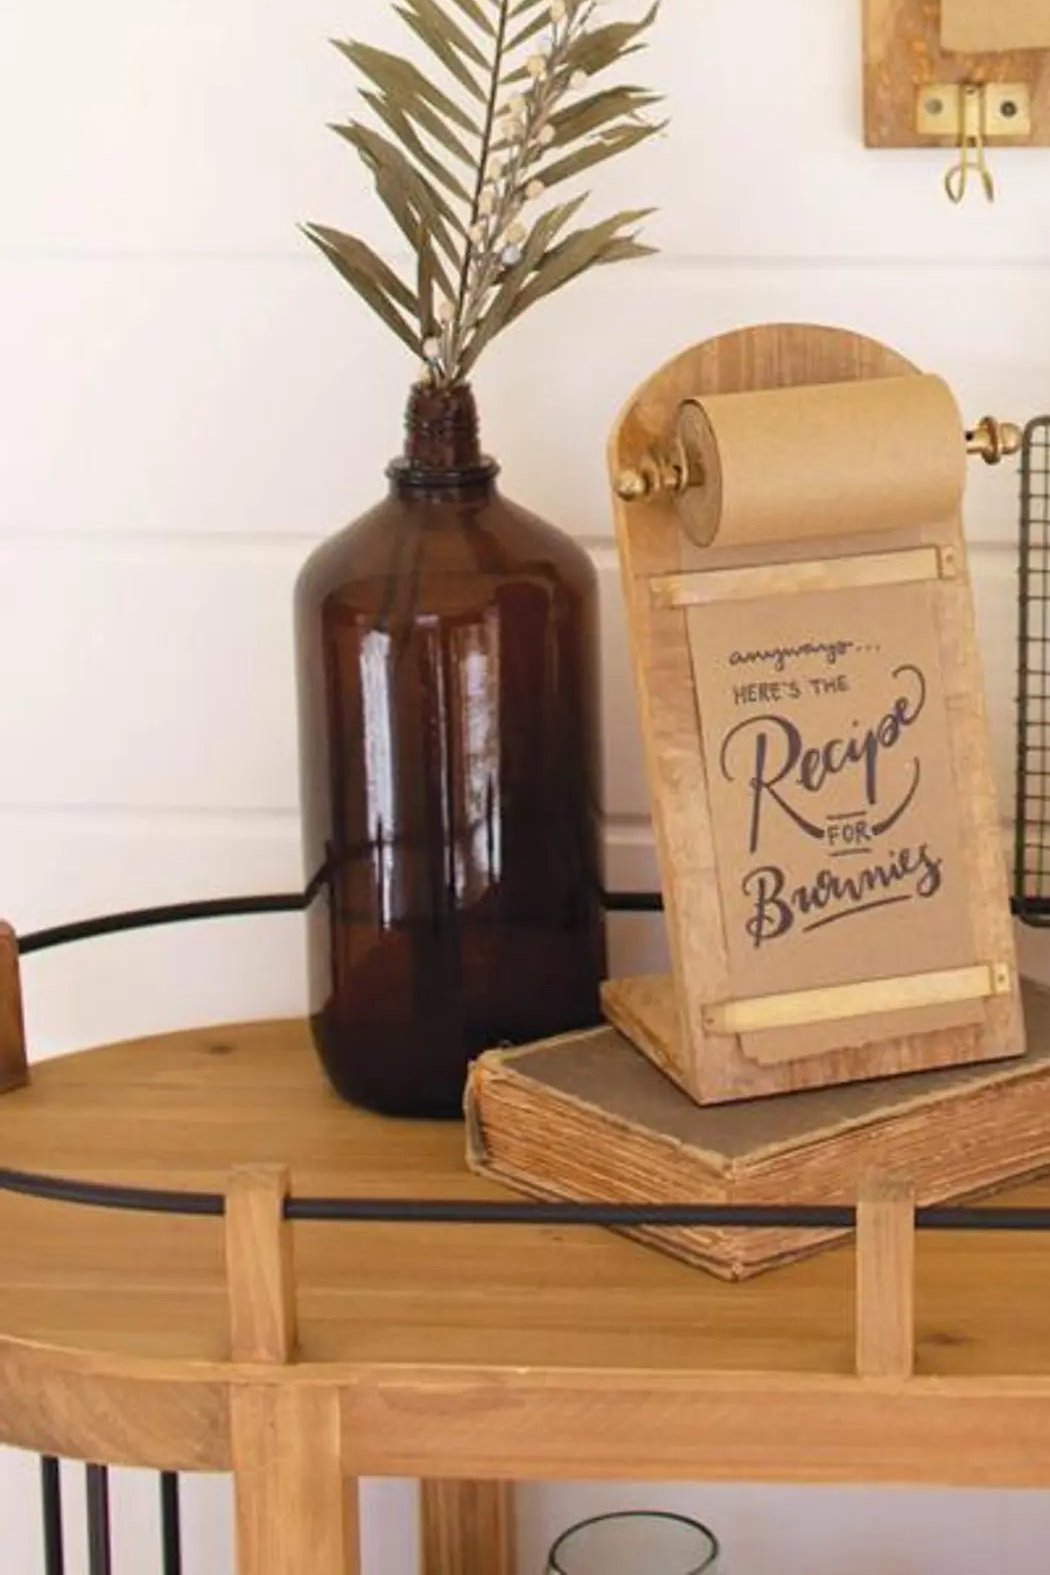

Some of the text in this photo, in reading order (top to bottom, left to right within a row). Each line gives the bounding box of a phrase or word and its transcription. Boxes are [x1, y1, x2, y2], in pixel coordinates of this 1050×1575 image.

[732, 674, 850, 705] HERE'S THE
[719, 664, 926, 854] Recipe
[826, 822, 872, 845] FOR
[741, 842, 943, 949] Brownies
